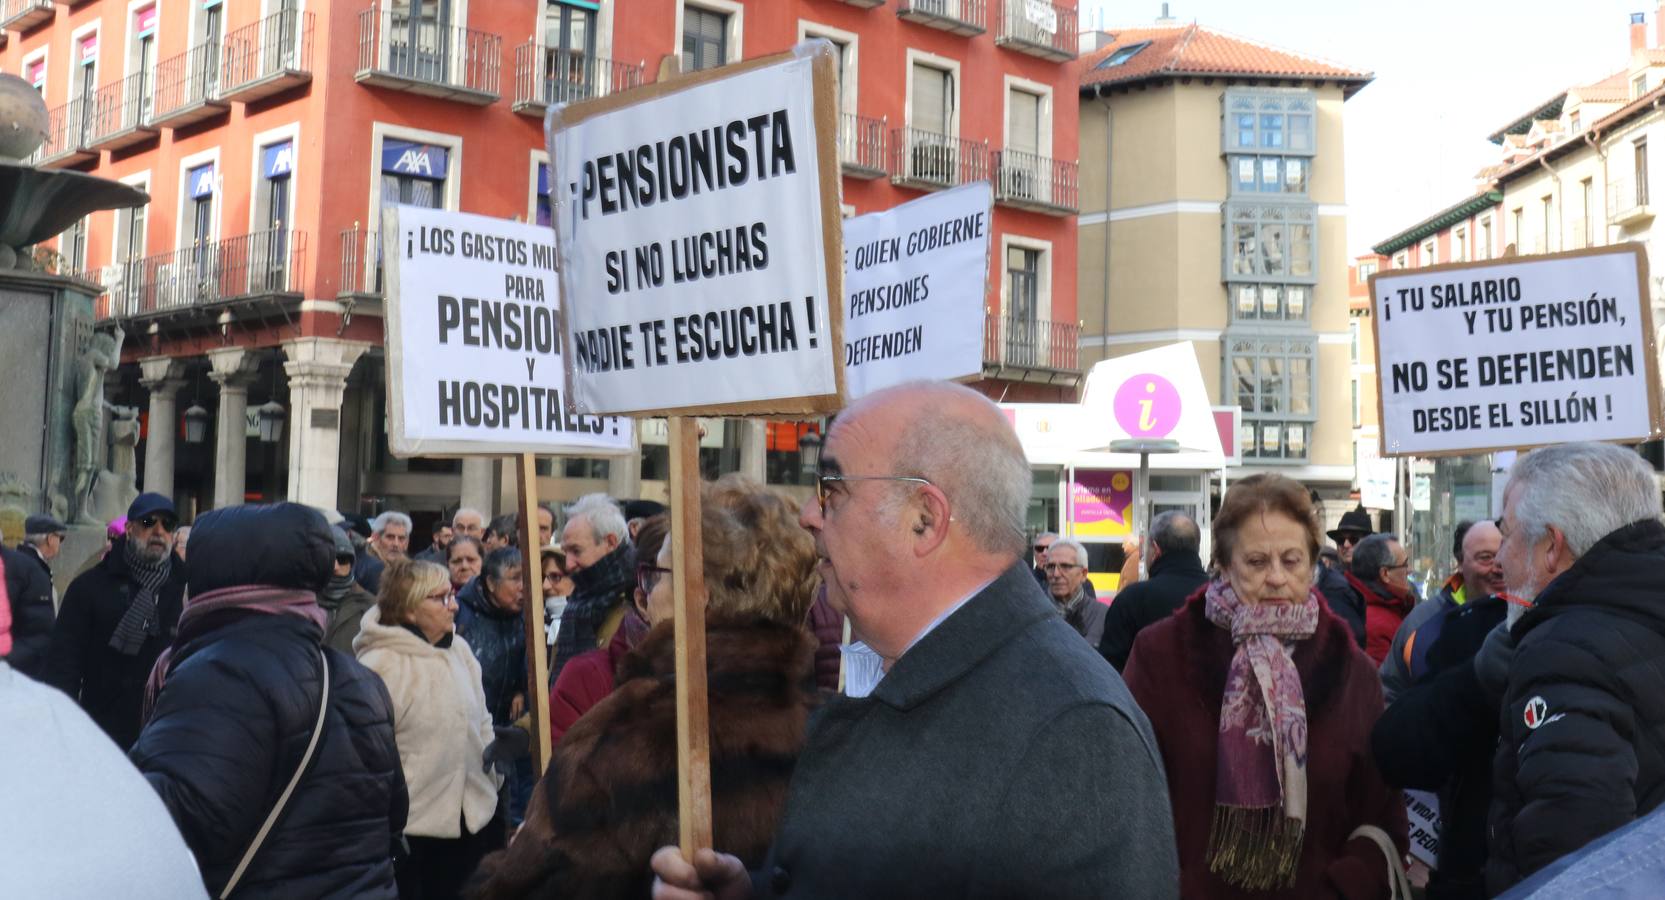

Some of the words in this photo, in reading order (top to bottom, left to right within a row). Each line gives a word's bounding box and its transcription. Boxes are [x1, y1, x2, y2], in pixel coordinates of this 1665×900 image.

[393, 149, 432, 176] AXA
[420, 226, 455, 256] LOS
[461, 231, 528, 267] GASTOS
[605, 250, 630, 295] SI
[636, 242, 665, 290] NO
[671, 222, 769, 284] LUCHAS
[855, 236, 901, 271] QUIEN
[907, 212, 984, 256] GOBIERNE
[505, 274, 545, 302] PARA
[850, 274, 930, 319] PENSIONES
[1397, 288, 1424, 313] TU
[1431, 277, 1521, 309] SALARIO
[1463, 311, 1477, 335] Y
[1484, 308, 1513, 334] TU
[1520, 293, 1626, 331] PENSIÓN,
[575, 323, 635, 373] NADIE
[640, 319, 668, 367] TE
[673, 301, 799, 363] ESCUCHA
[525, 357, 536, 382] Y
[1392, 361, 1428, 393] NO
[1437, 358, 1469, 390] SE
[1478, 344, 1634, 387] DEFIENDEN
[1413, 405, 1481, 434] DESDE
[1488, 403, 1513, 428] EL
[1521, 391, 1597, 427] SILLÓN
[1073, 486, 1100, 495] urismo
[1073, 495, 1111, 504] alladolid
[1412, 802, 1436, 822] VIDA
